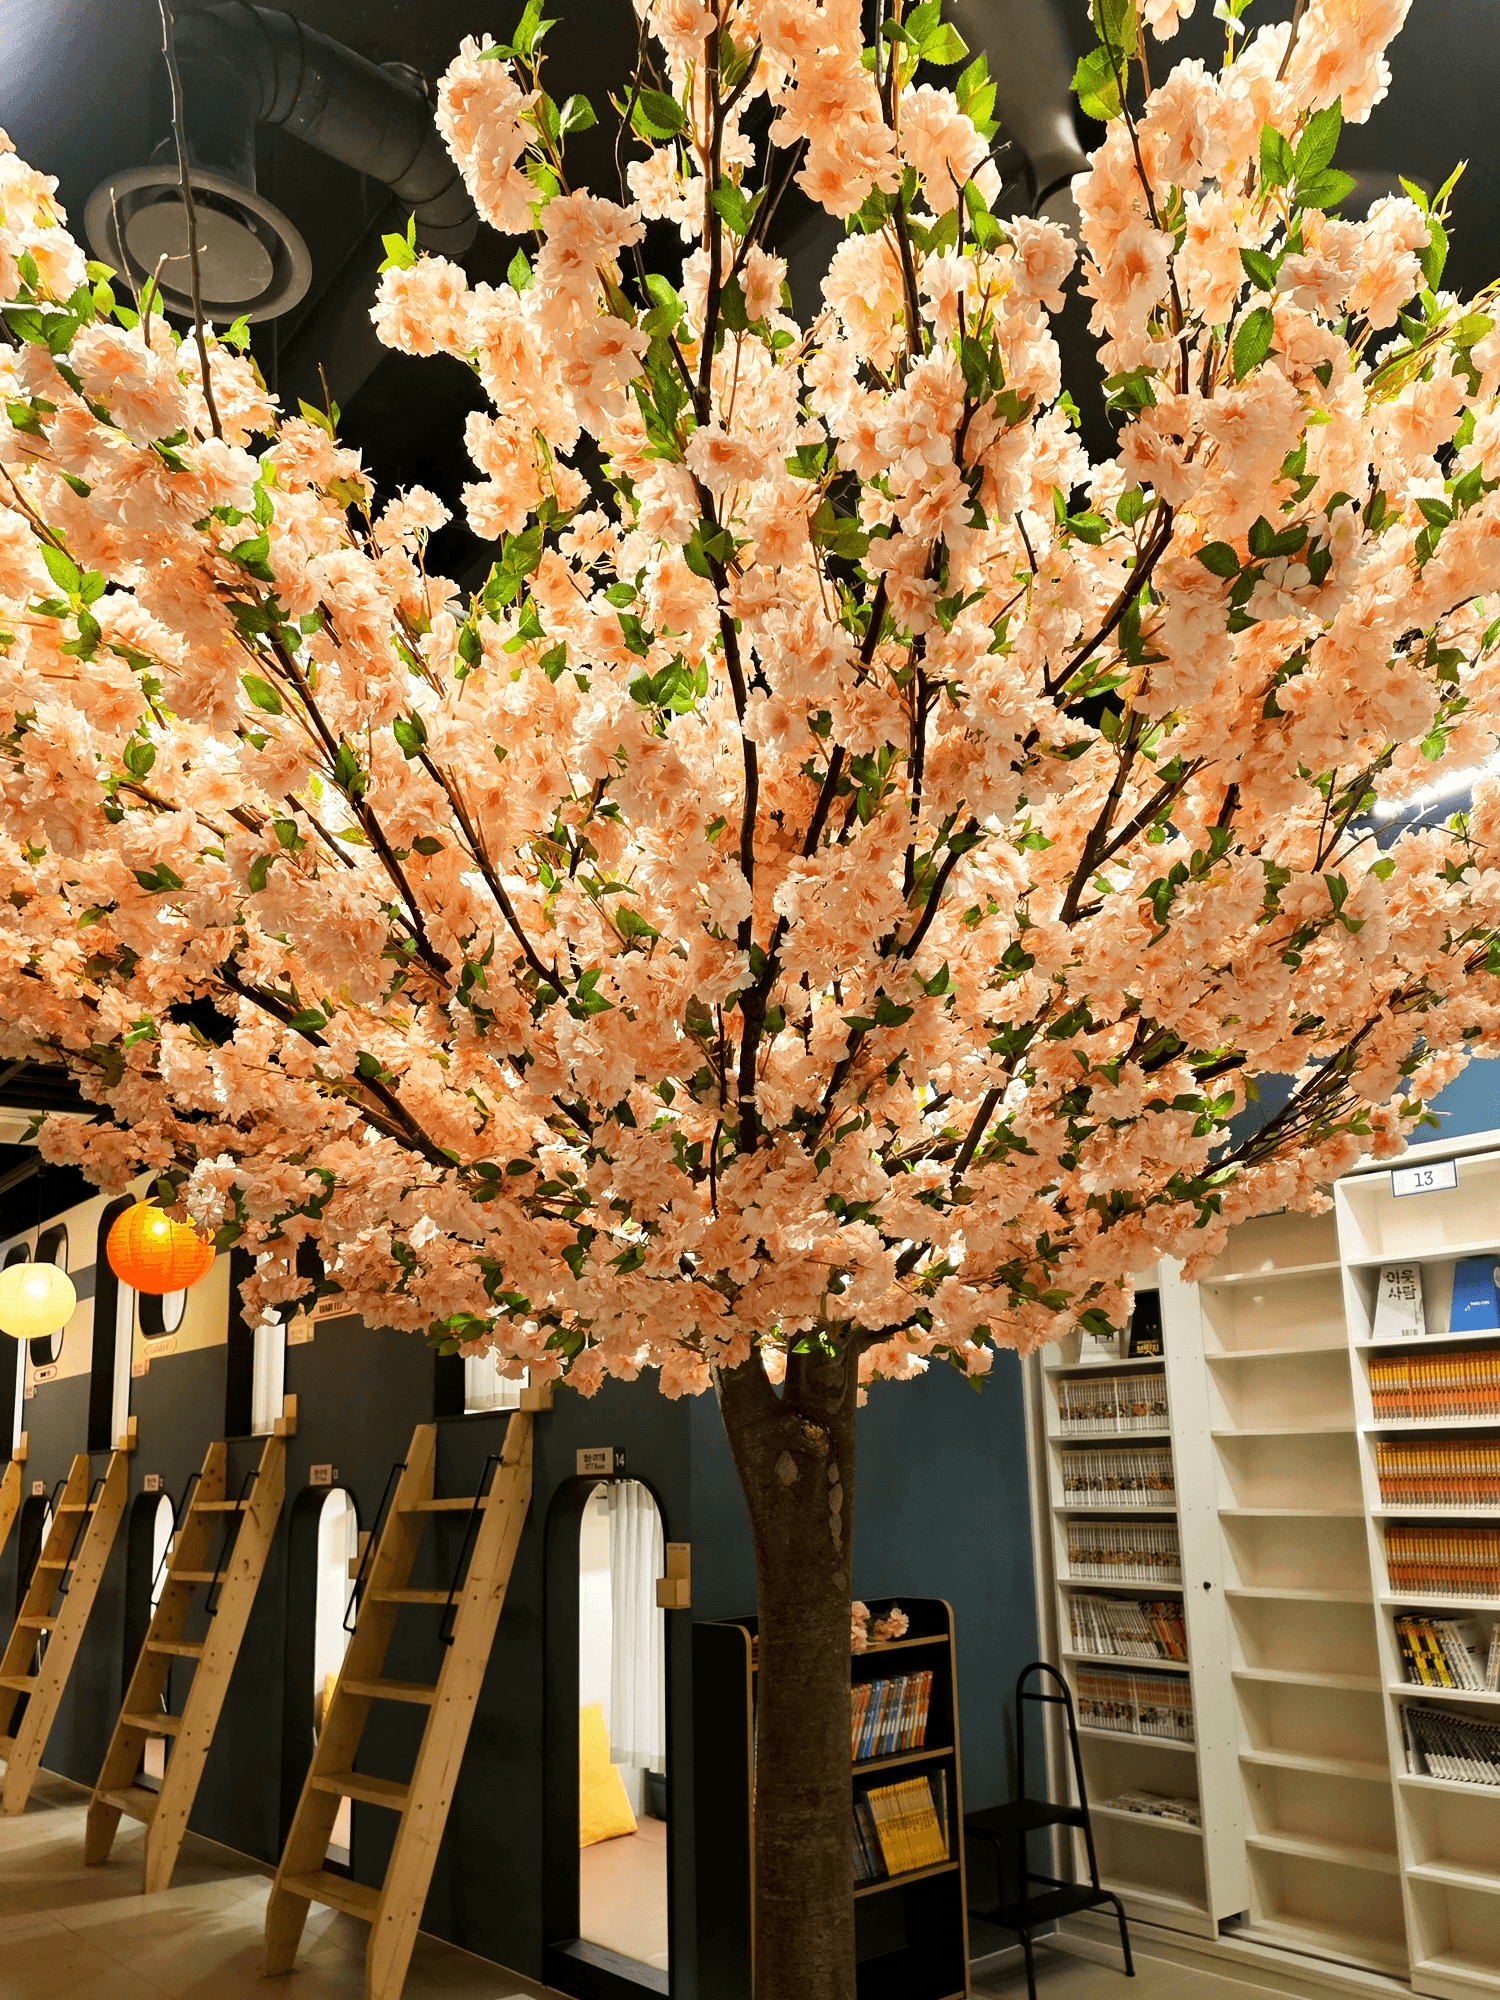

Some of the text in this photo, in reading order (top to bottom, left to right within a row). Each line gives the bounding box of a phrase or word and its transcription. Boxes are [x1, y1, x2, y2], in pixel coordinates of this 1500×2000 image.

[1414, 1171, 1433, 1187] 13
[1386, 1269, 1415, 1284] 이웃
[1388, 1285, 1416, 1300] 사람
[1137, 1343, 1159, 1357] 브릿지
[615, 1453, 625, 1466] 14
